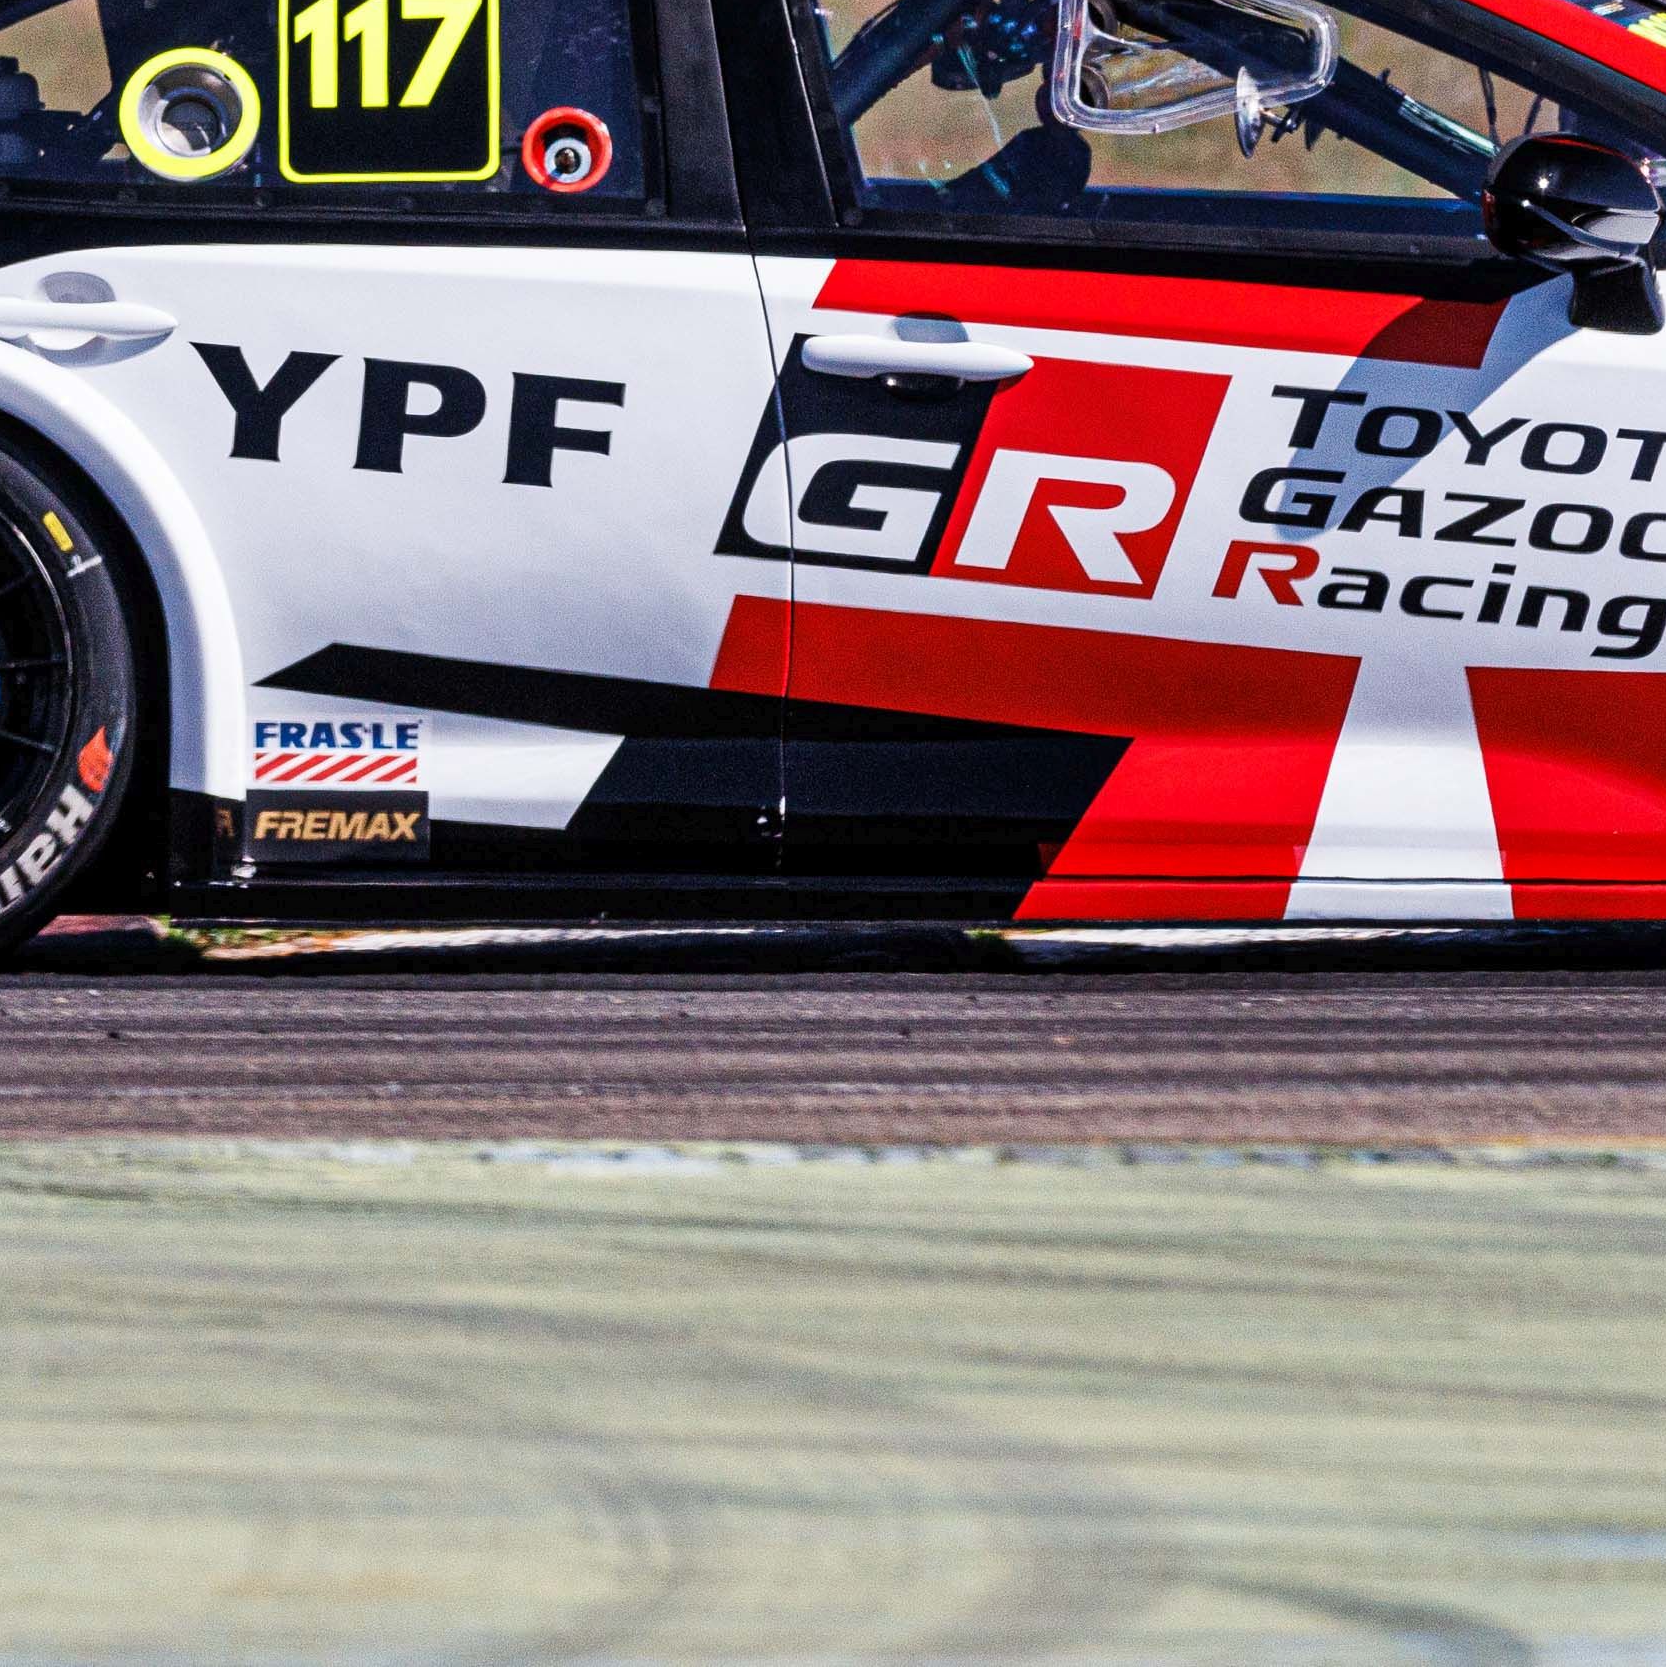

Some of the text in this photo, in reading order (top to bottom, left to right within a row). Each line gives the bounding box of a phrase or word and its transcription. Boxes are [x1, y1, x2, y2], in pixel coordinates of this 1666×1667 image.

[189, 341, 625, 488] YPF
[742, 431, 1178, 586] GR
[253, 811, 421, 841] FREMAX
